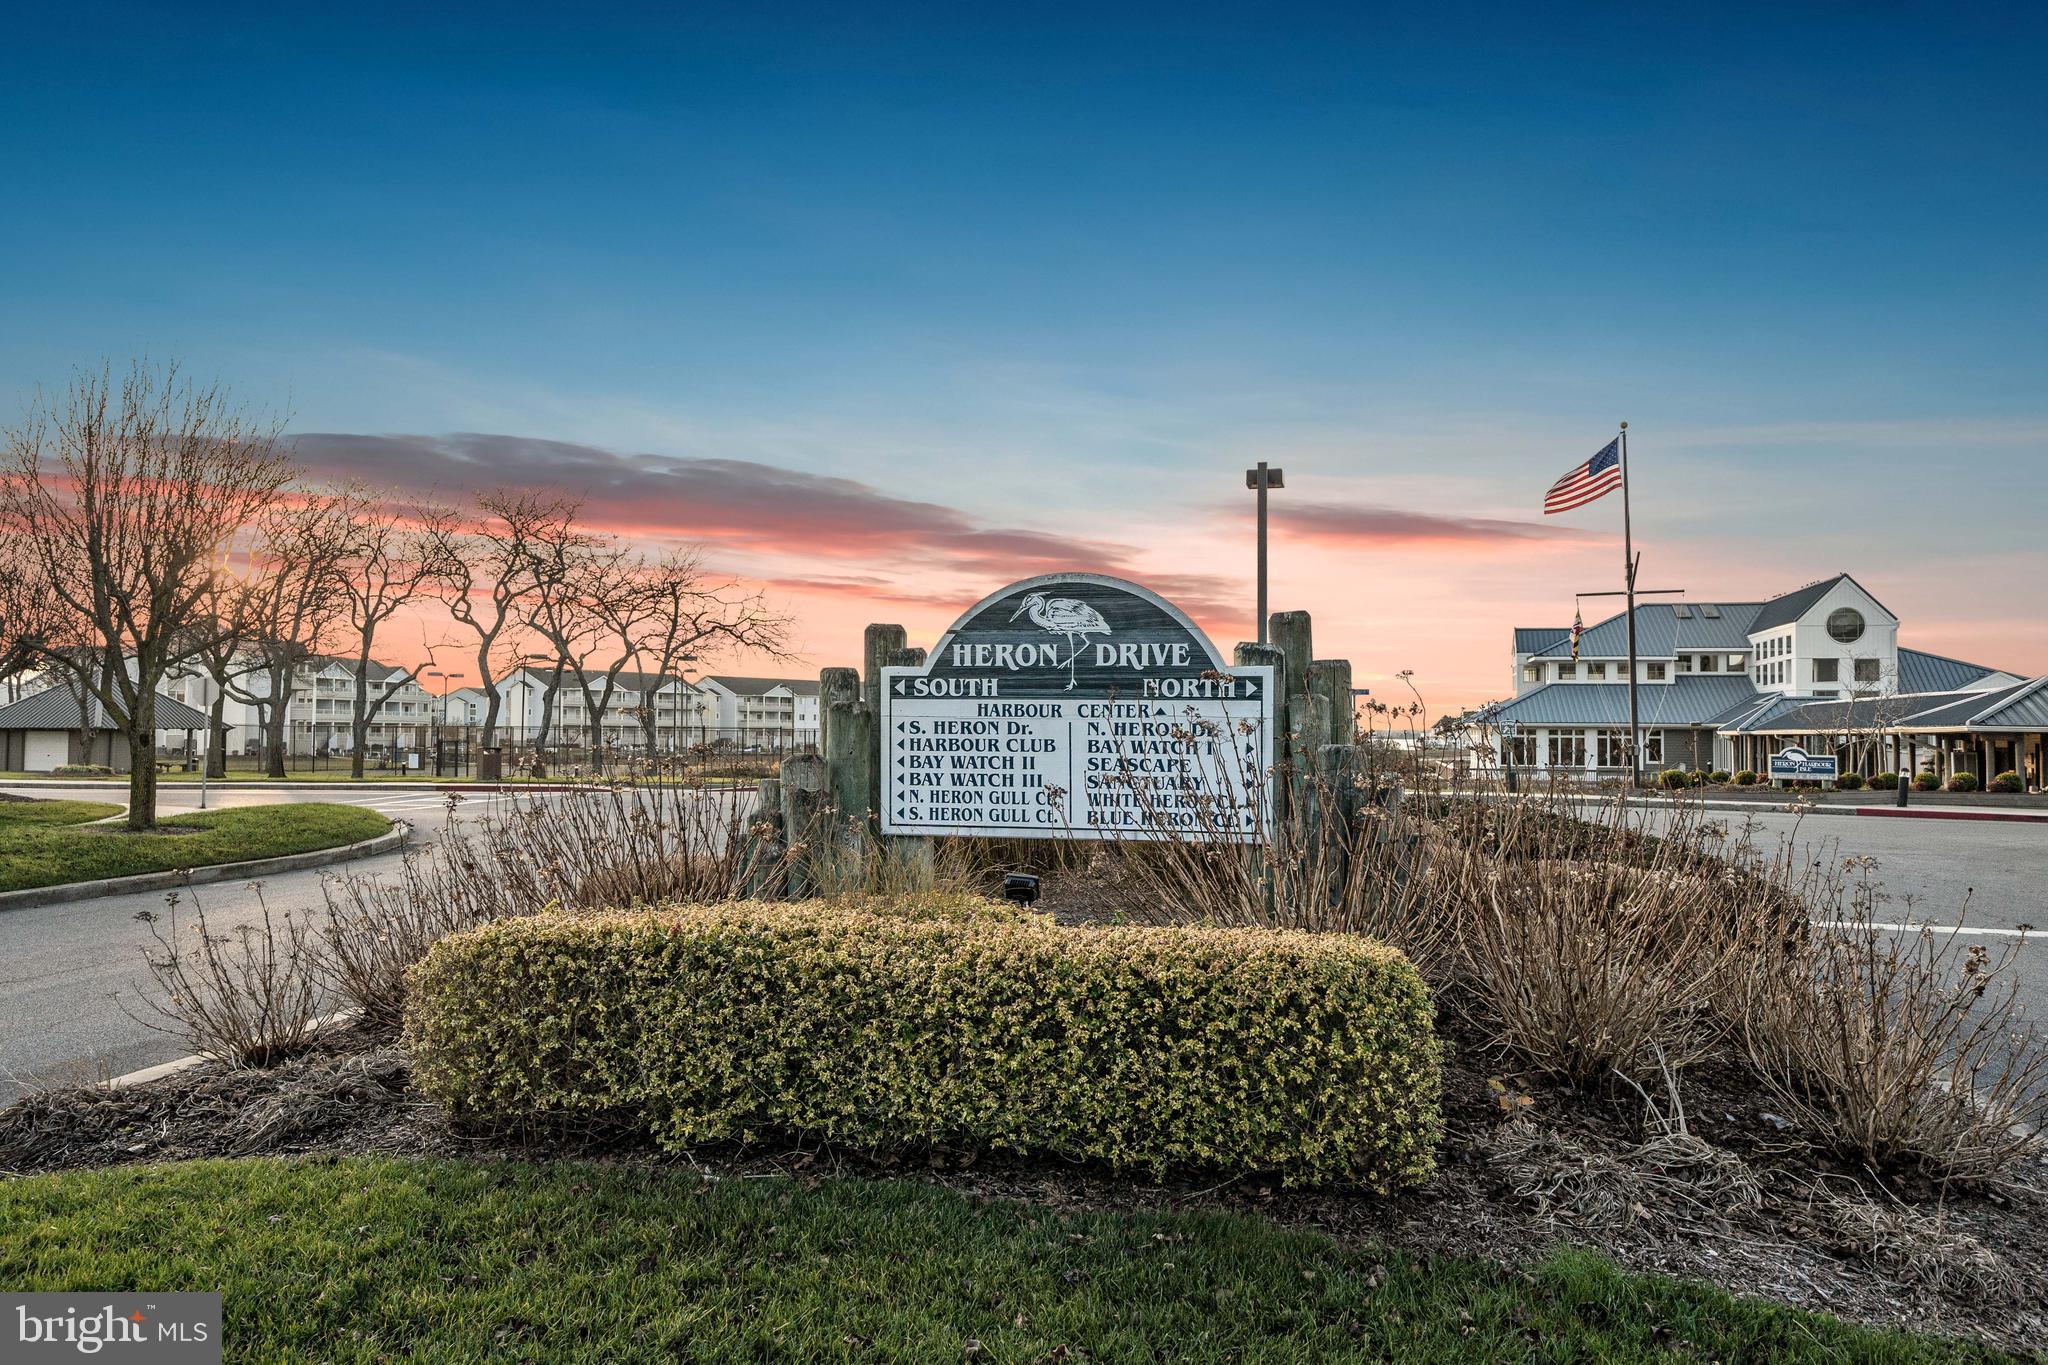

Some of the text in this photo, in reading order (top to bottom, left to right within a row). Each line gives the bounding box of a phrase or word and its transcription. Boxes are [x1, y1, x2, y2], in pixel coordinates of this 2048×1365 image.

[952, 643, 1191, 670] HERON DRIVE
[914, 678, 998, 696] SOUTH
[1143, 678, 1236, 697] NORTH
[977, 704, 1150, 718] HARBOUR CENTER
[909, 721, 1032, 735] S. HERON Dr.
[1088, 722, 1105, 736] N.
[909, 738, 1056, 752] HARBOUR CLUB
[1088, 740, 1122, 753] BAY
[1131, 741, 1198, 755] WATCH
[909, 756, 1035, 769] BAY WATCH II
[1088, 758, 1192, 772] SEASCAPE
[909, 773, 1042, 787] BAY WATCH III
[909, 790, 923, 803] N.
[930, 790, 983, 804] HERON
[989, 791, 1029, 805] GULL
[1088, 793, 1143, 807] WHITE
[1150, 794, 1212, 808] HERO
[909, 807, 1057, 823] S. HERON GULL Ct.
[1087, 811, 1134, 825] BLUE
